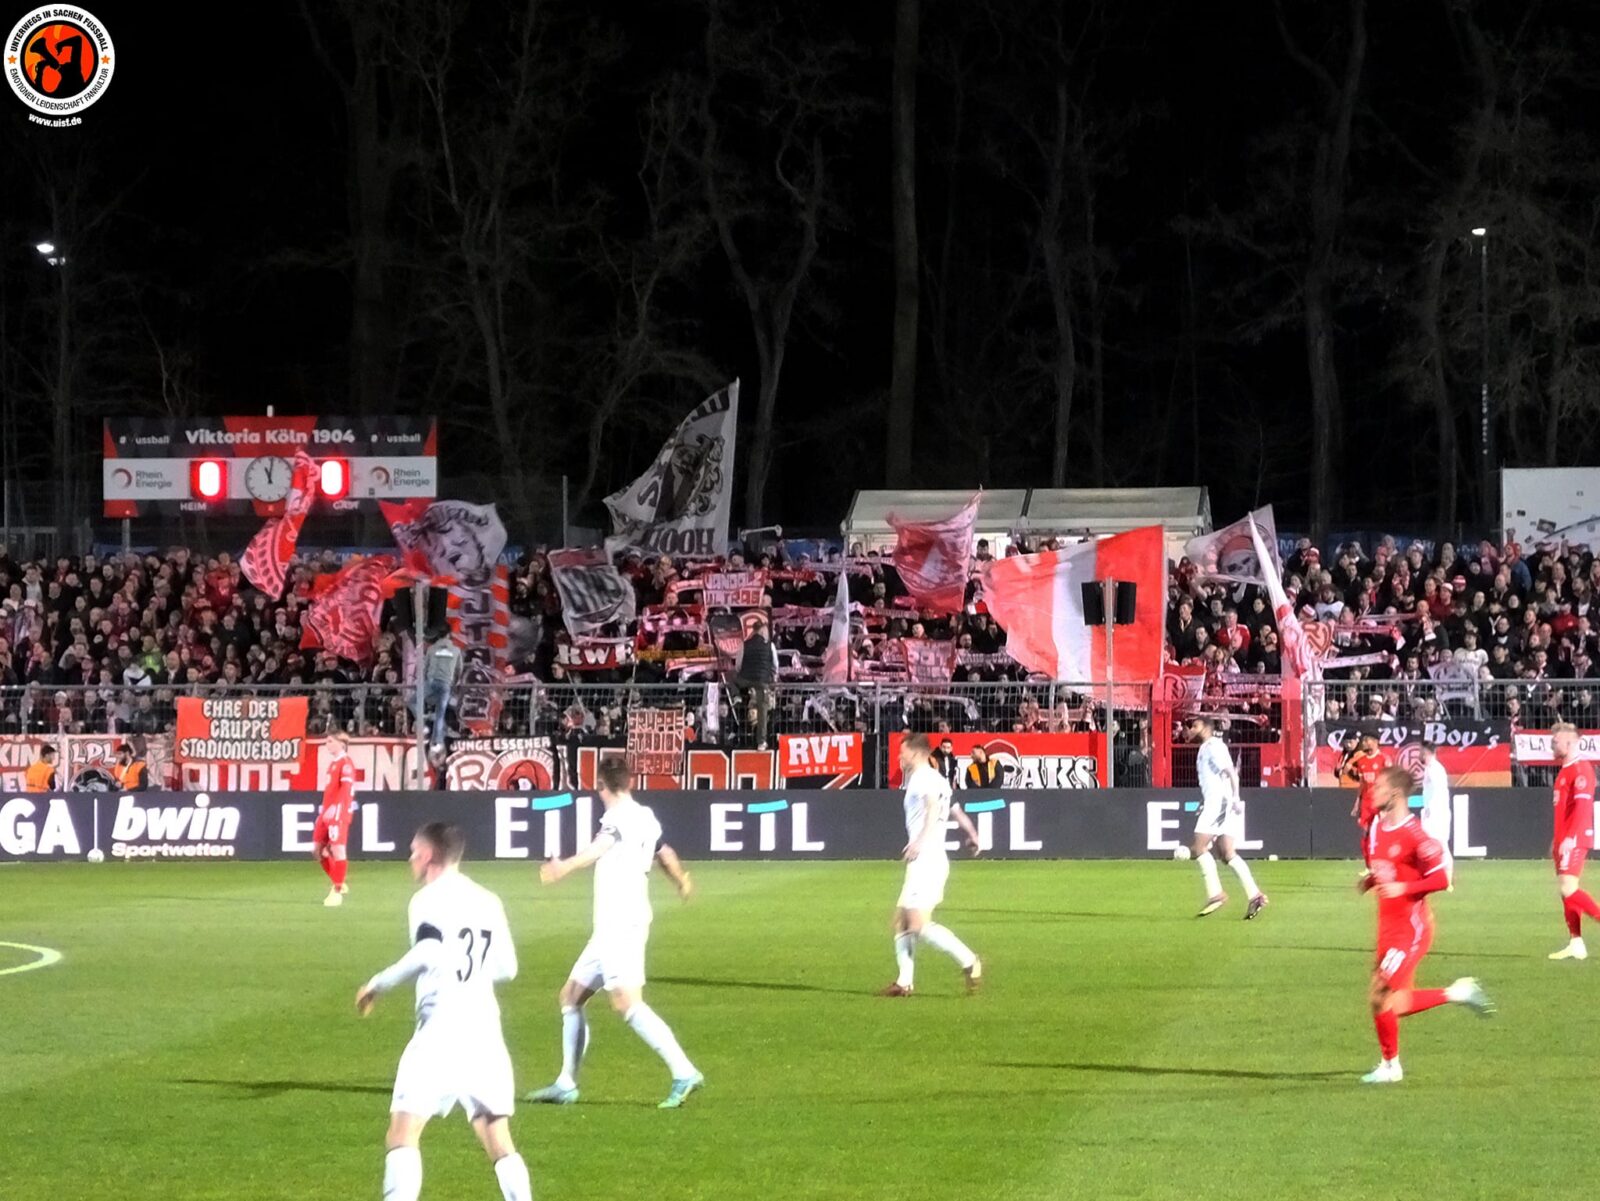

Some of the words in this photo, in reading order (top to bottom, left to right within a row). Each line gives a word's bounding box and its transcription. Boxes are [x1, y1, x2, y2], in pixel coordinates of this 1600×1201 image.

[185, 428, 261, 445] Viktoria
[265, 427, 308, 445] Köln
[313, 428, 355, 444] 1904
[135, 469, 163, 480] Rhein
[199, 460, 220, 497] 0
[321, 460, 342, 496] 0
[393, 468, 421, 478] Rhein
[393, 477, 430, 487] Energie
[135, 478, 172, 489] Energie
[180, 502, 208, 511] HEIM
[706, 590, 761, 605] ULTRAS
[203, 700, 243, 718] EHRE
[248, 700, 278, 718] DER
[210, 719, 270, 738] GRUPPE
[628, 711, 684, 732] GRUPPE
[180, 738, 300, 760] STADIONVERBOT
[450, 740, 492, 752] JUNGE
[493, 736, 551, 751] ESSENER
[627, 732, 684, 753] STADION
[788, 734, 854, 765] RVT
[71, 743, 117, 763] LPL
[111, 793, 241, 841] bwin
[710, 800, 825, 852] ETL
[282, 803, 395, 853] EL
[111, 841, 235, 858] Sportwetten
[456, 927, 493, 983] 37
